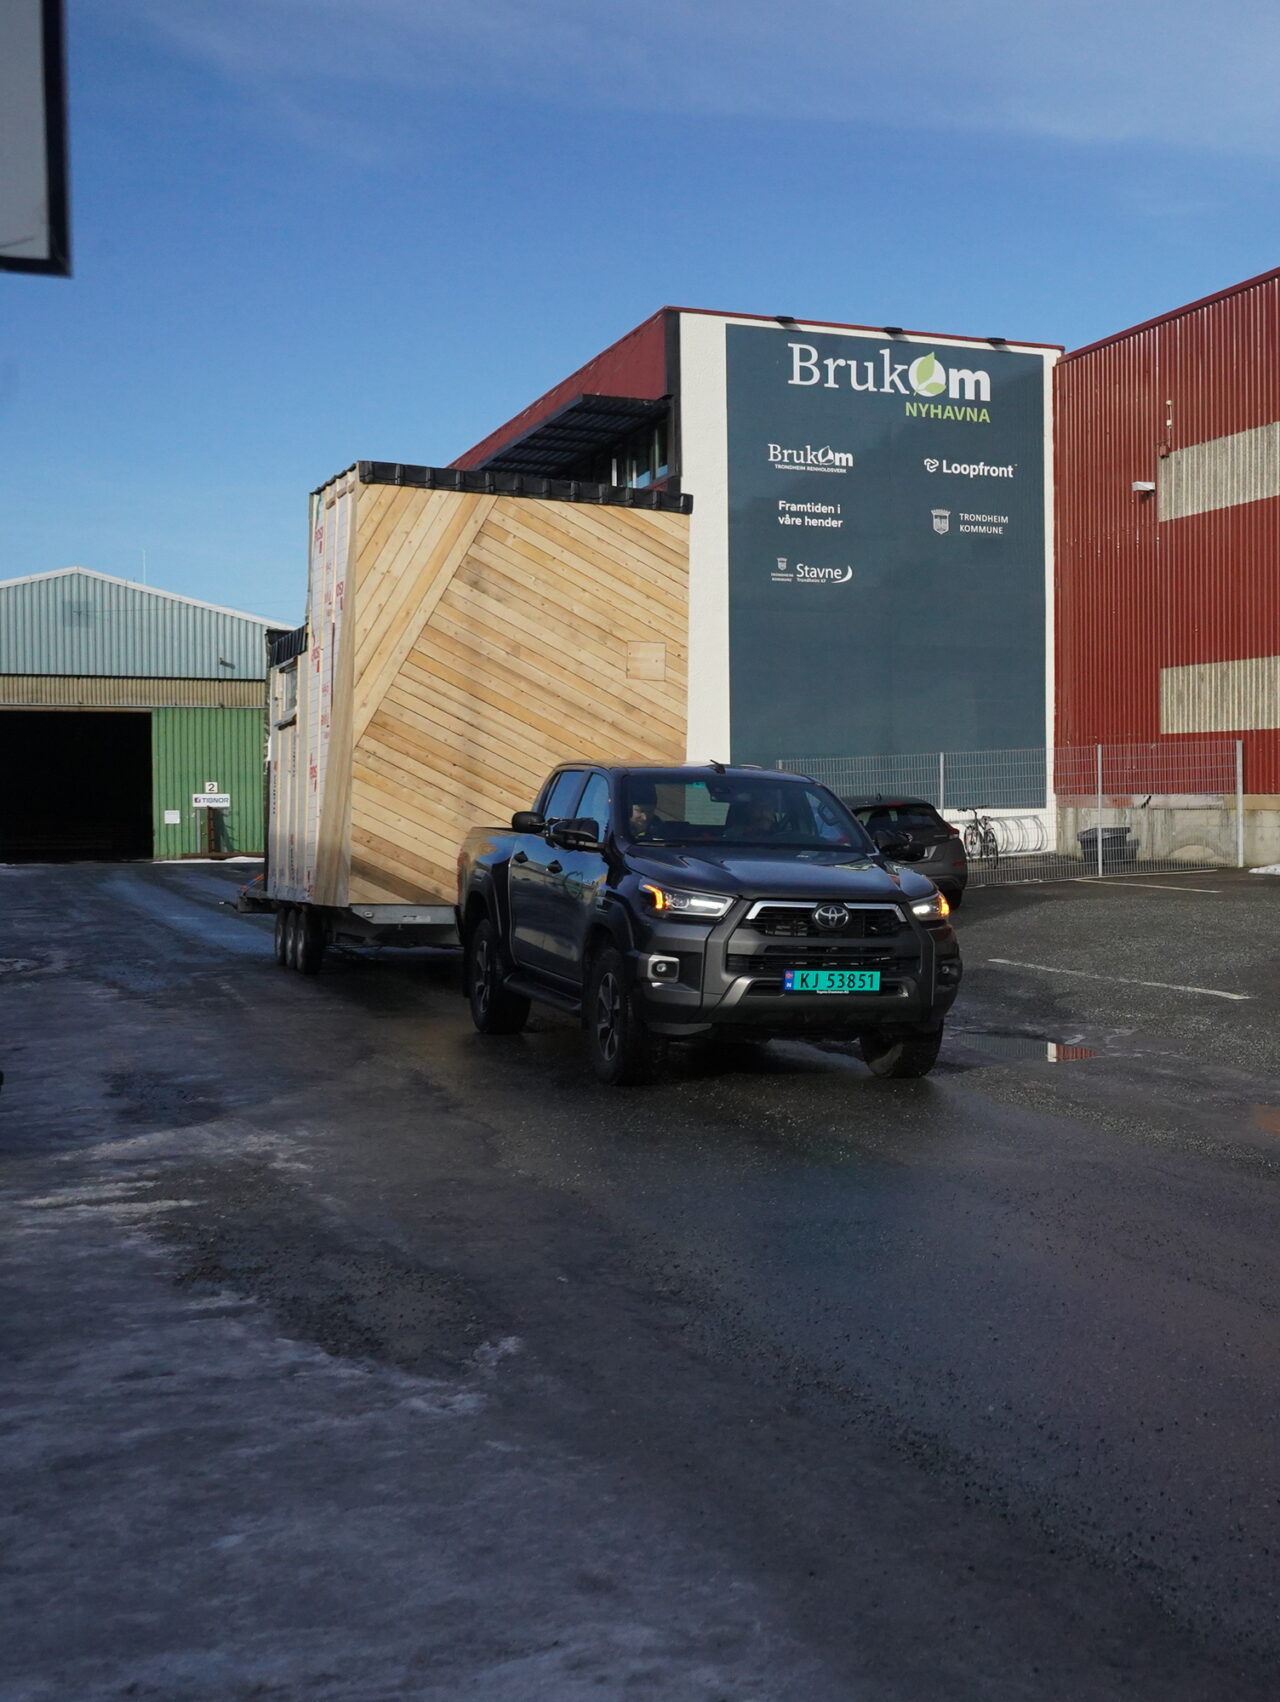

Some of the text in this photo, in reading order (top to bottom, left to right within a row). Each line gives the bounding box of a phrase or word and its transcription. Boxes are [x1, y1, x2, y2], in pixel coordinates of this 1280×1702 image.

[787, 342, 991, 401] BrukOm
[905, 401, 991, 423] NYHAVNA
[767, 443, 854, 467] BrukOm
[942, 459, 1014, 478] Loopfront
[778, 500, 841, 514] Framtiden i
[778, 514, 843, 528] våre hender
[959, 512, 1009, 524] TRONDHEIM
[959, 524, 1004, 534] KOMMUNE
[796, 562, 842, 579] Stavne
[208, 783, 215, 792] 2
[800, 973, 874, 989] KJ 53851
